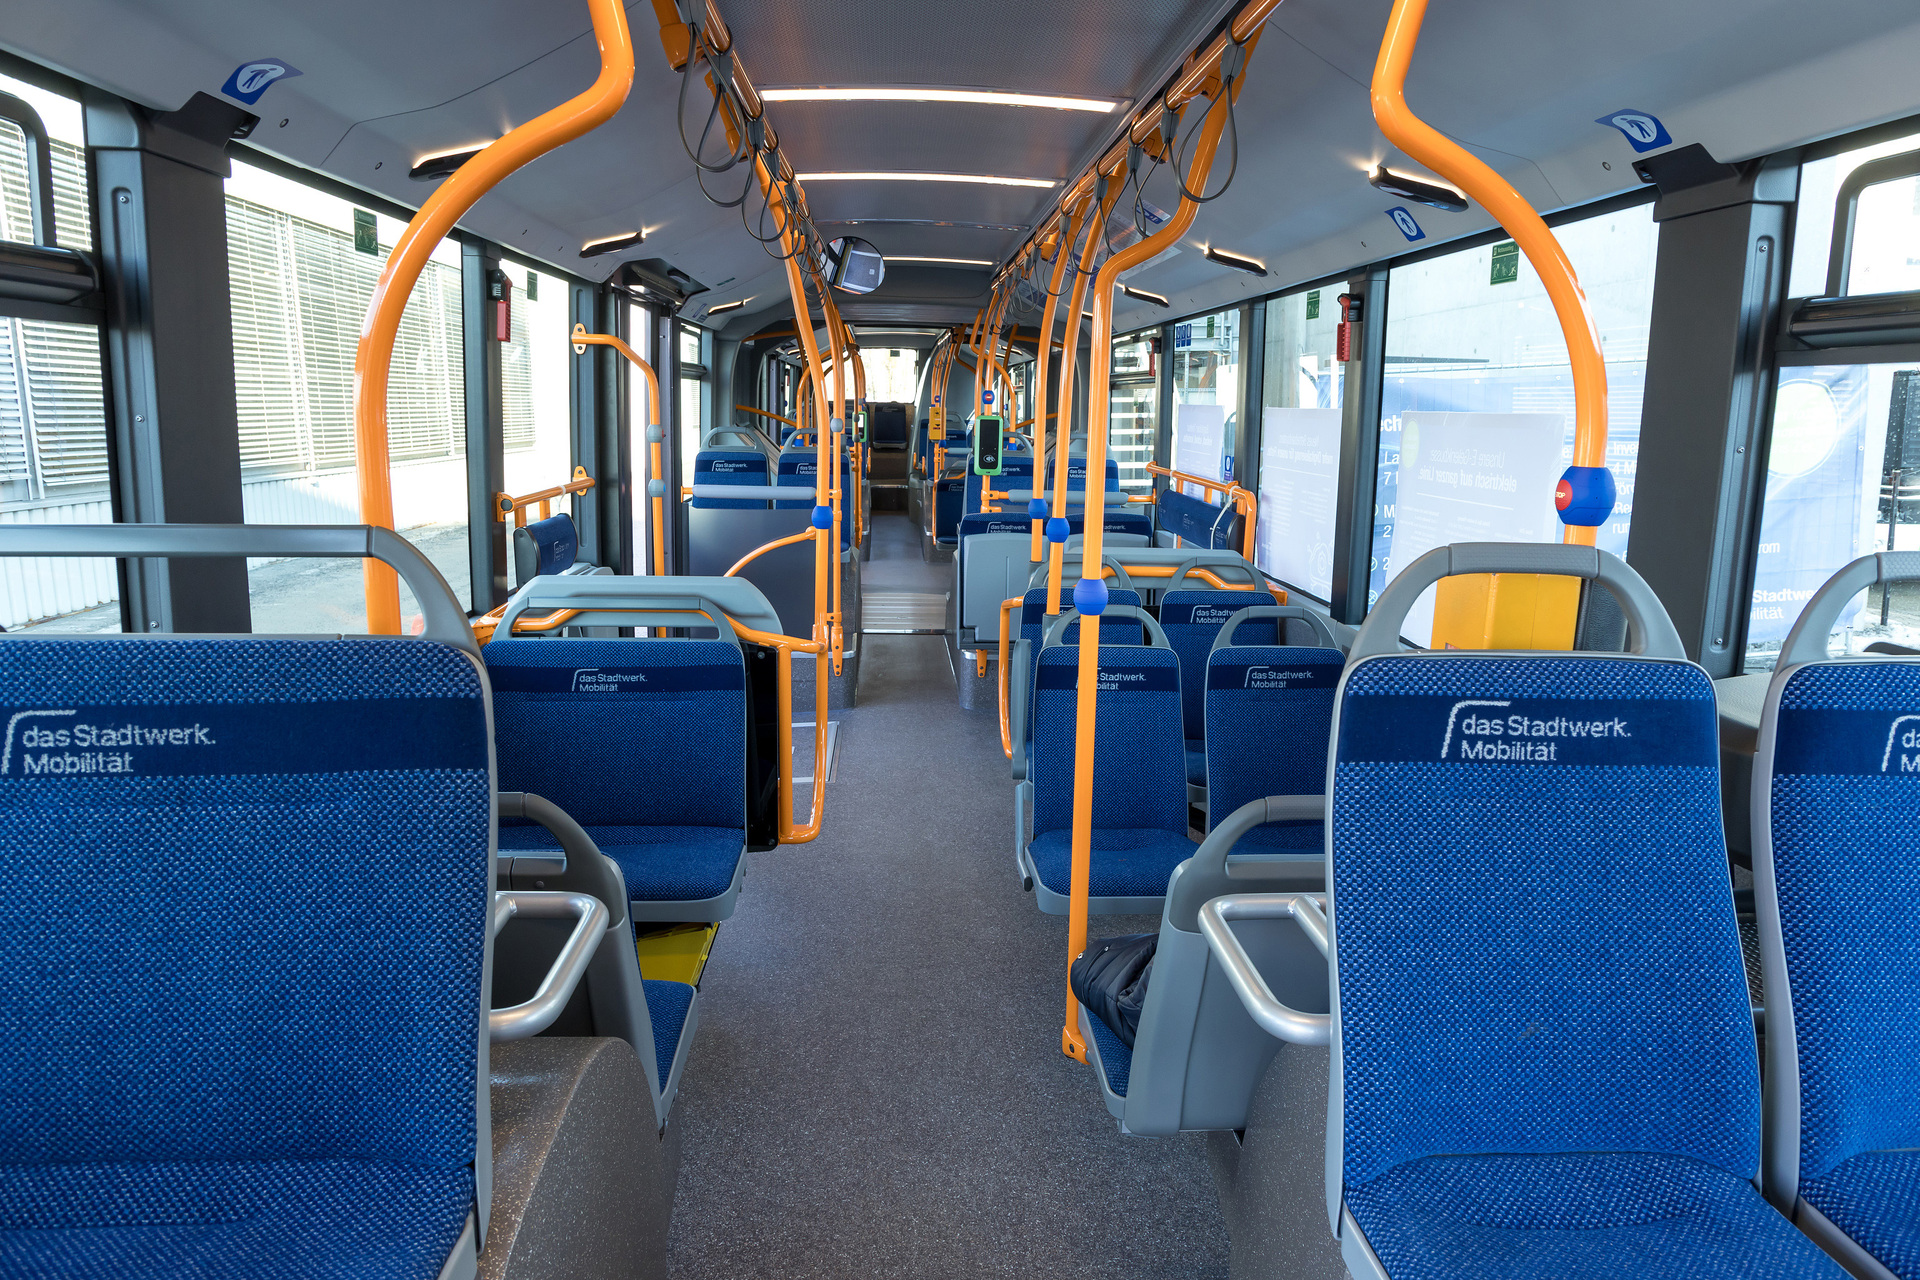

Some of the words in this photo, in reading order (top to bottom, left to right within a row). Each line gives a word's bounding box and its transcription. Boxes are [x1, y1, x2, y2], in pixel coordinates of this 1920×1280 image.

[1751, 606, 1784, 620] ilität
[580, 674, 597, 683] das
[597, 673, 648, 683] Stadtwerk.
[1100, 672, 1147, 681] Stadtwerk.
[1251, 671, 1268, 680] das
[1268, 670, 1315, 680] Stadtwerk.
[579, 684, 619, 692] Mobilität
[1097, 682, 1119, 690] bilität
[1251, 681, 1287, 689] Mobilität
[1462, 714, 1505, 736] das
[1507, 714, 1633, 738] Stadtwerk.
[22, 725, 71, 748] das
[73, 723, 217, 747] Stadtwerk.
[1461, 740, 1558, 761] Mobilität
[22, 752, 134, 775] Mobilität
